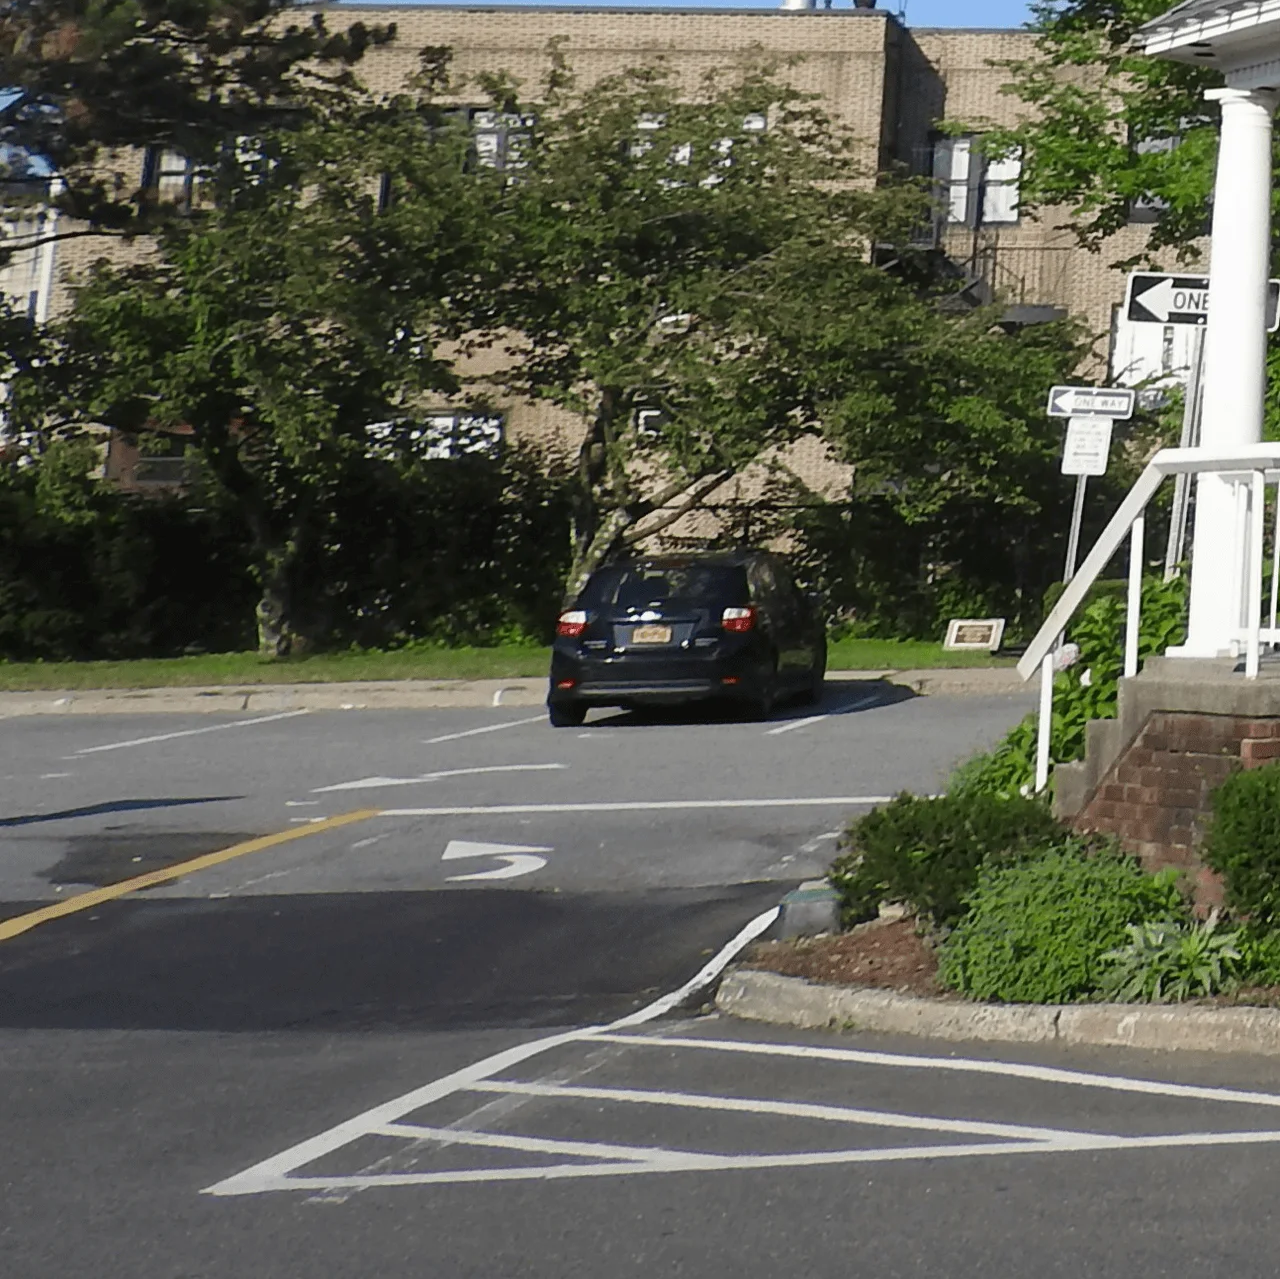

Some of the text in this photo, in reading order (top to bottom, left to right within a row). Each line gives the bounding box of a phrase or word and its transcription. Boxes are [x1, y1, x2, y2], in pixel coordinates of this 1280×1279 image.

[1173, 291, 1210, 311] ONE
[1074, 397, 1124, 409] ONE WAY
